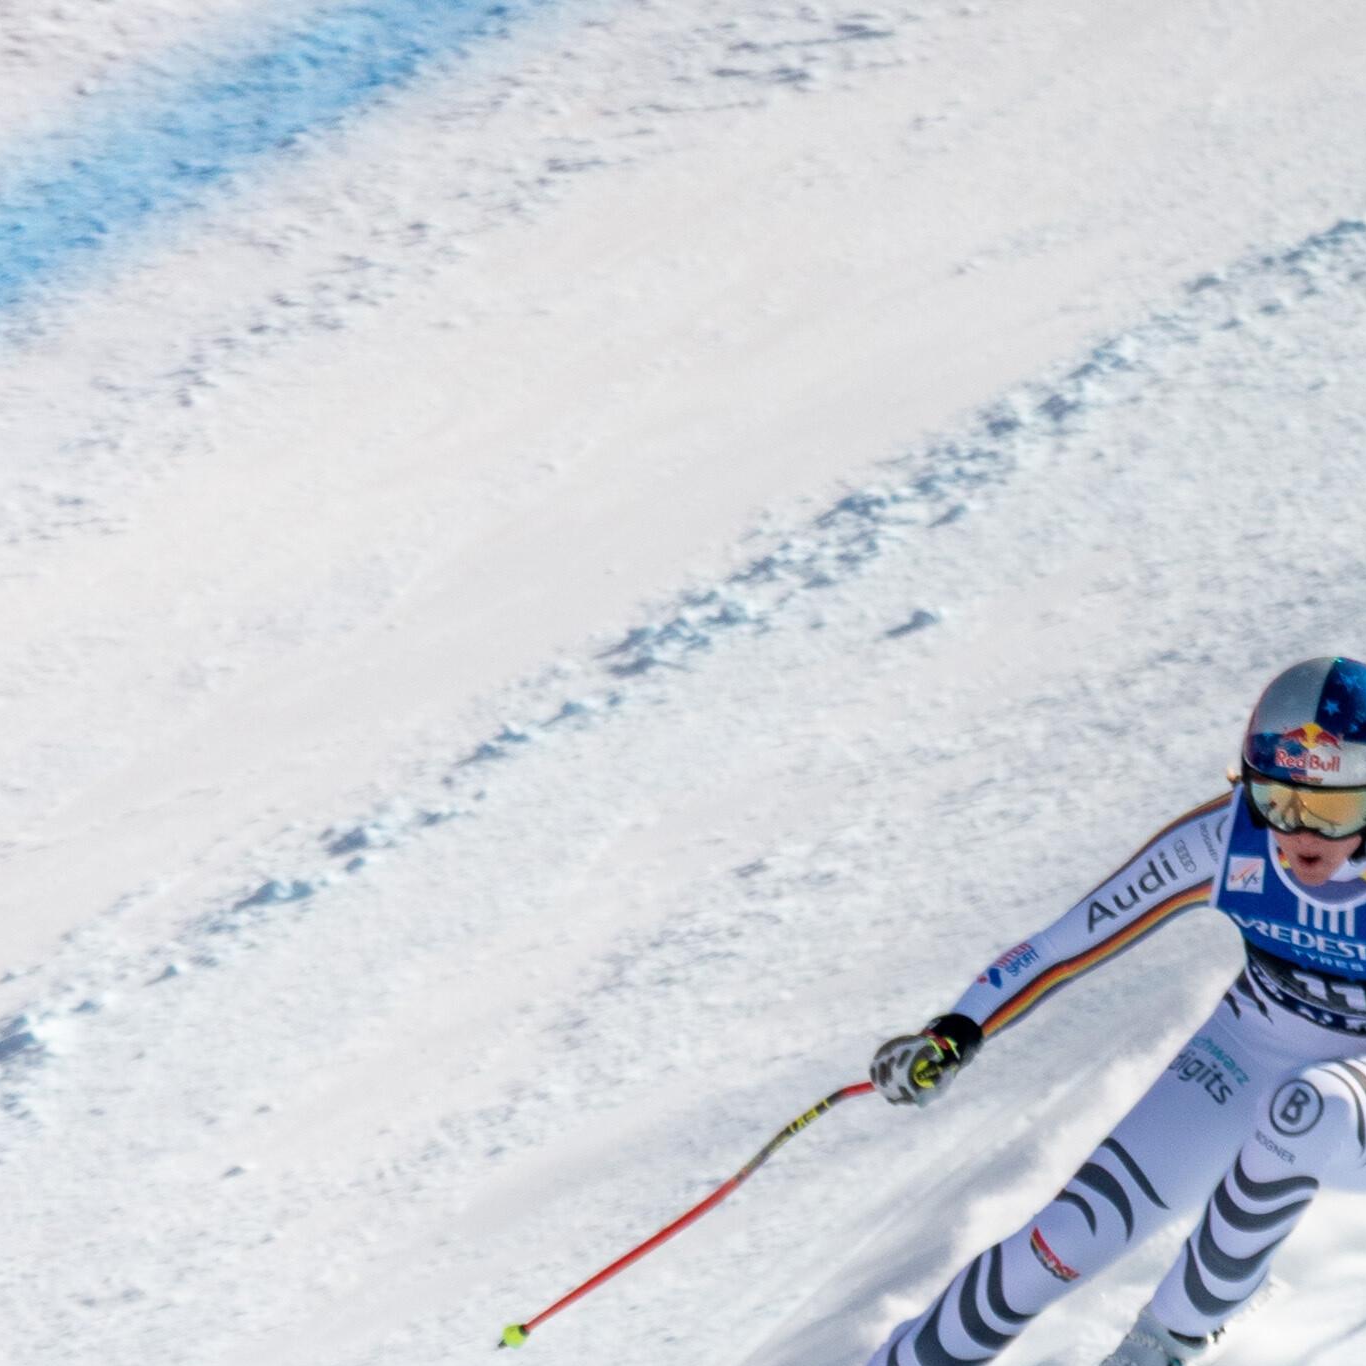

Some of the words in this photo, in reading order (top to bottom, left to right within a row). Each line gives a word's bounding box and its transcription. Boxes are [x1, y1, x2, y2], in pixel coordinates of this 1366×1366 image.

[1275, 750, 1307, 769] Red
[1309, 754, 1340, 772] Bull
[1087, 850, 1179, 933] Audi
[1292, 949, 1365, 972] TYRES
